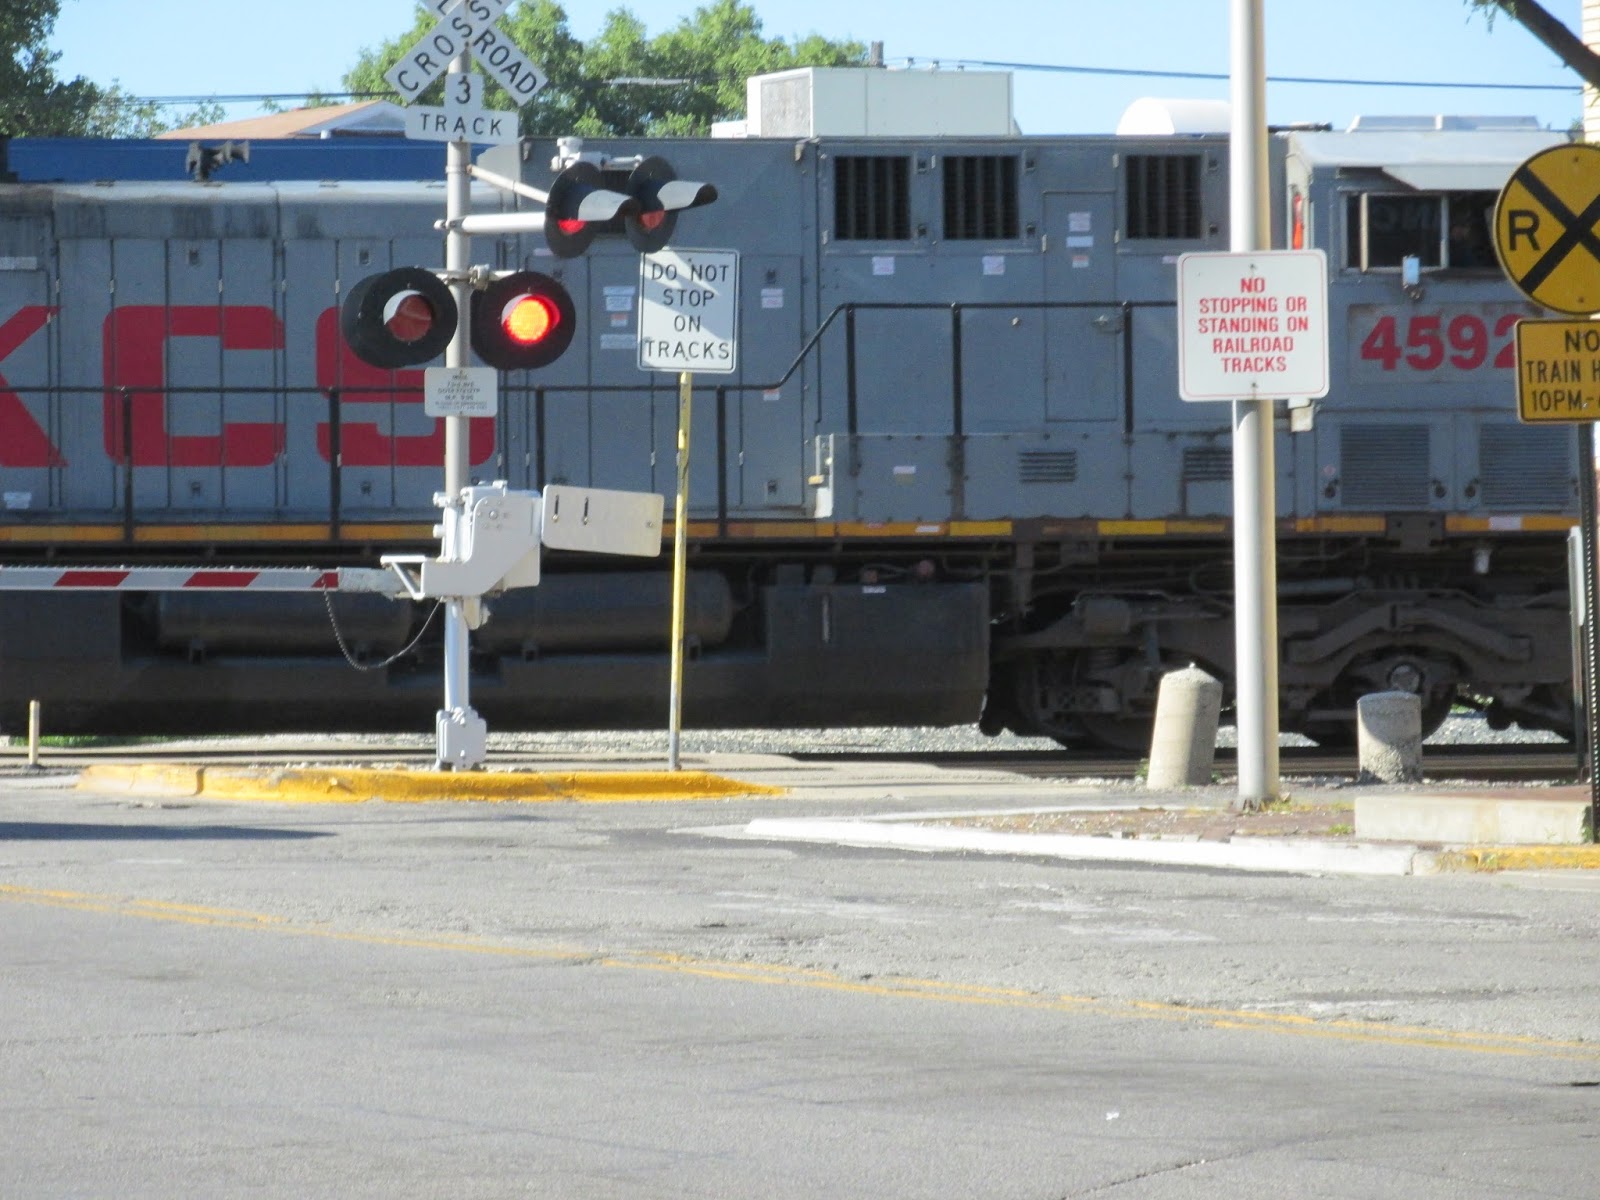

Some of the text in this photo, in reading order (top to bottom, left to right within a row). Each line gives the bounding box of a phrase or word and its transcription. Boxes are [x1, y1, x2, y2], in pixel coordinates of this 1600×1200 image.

[473, 29, 538, 94] ROAD
[455, 76, 471, 104] 3
[420, 113, 503, 136] TRACK
[1508, 209, 1541, 251] R
[651, 263, 730, 282] DO NOT
[1240, 277, 1266, 294] NO
[662, 288, 715, 307] STOP
[1199, 296, 1308, 314] STOPPING OR
[673, 315, 701, 333] ON
[1198, 316, 1309, 334] STANDING ON
[644, 339, 730, 360] TRACKS
[1212, 336, 1294, 354] RAILROAD
[1564, 329, 1600, 353] NO
[1222, 356, 1287, 373] TRACKS
[1525, 360, 1581, 383] TRAIN
[1532, 389, 1600, 411] 10PM-
